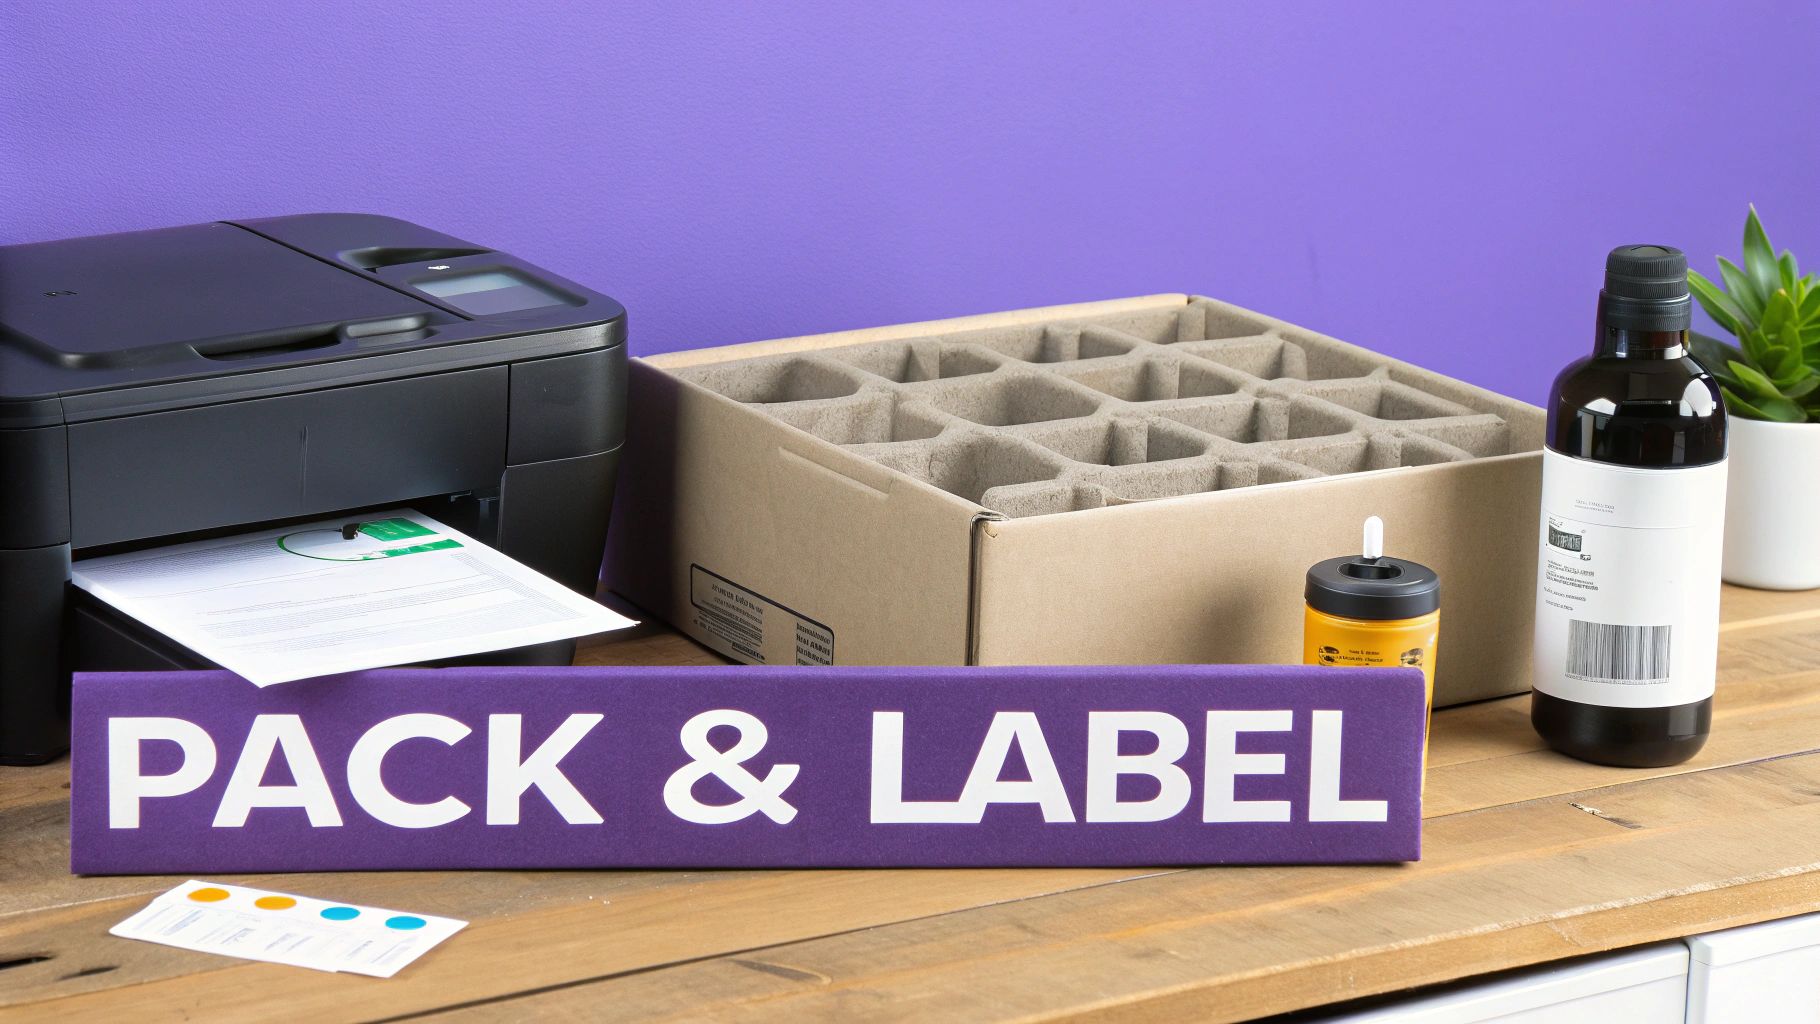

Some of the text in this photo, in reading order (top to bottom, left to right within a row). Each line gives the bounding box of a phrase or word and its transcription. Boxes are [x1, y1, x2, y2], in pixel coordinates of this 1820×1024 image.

[107, 708, 1389, 829] PACK & LABEL
